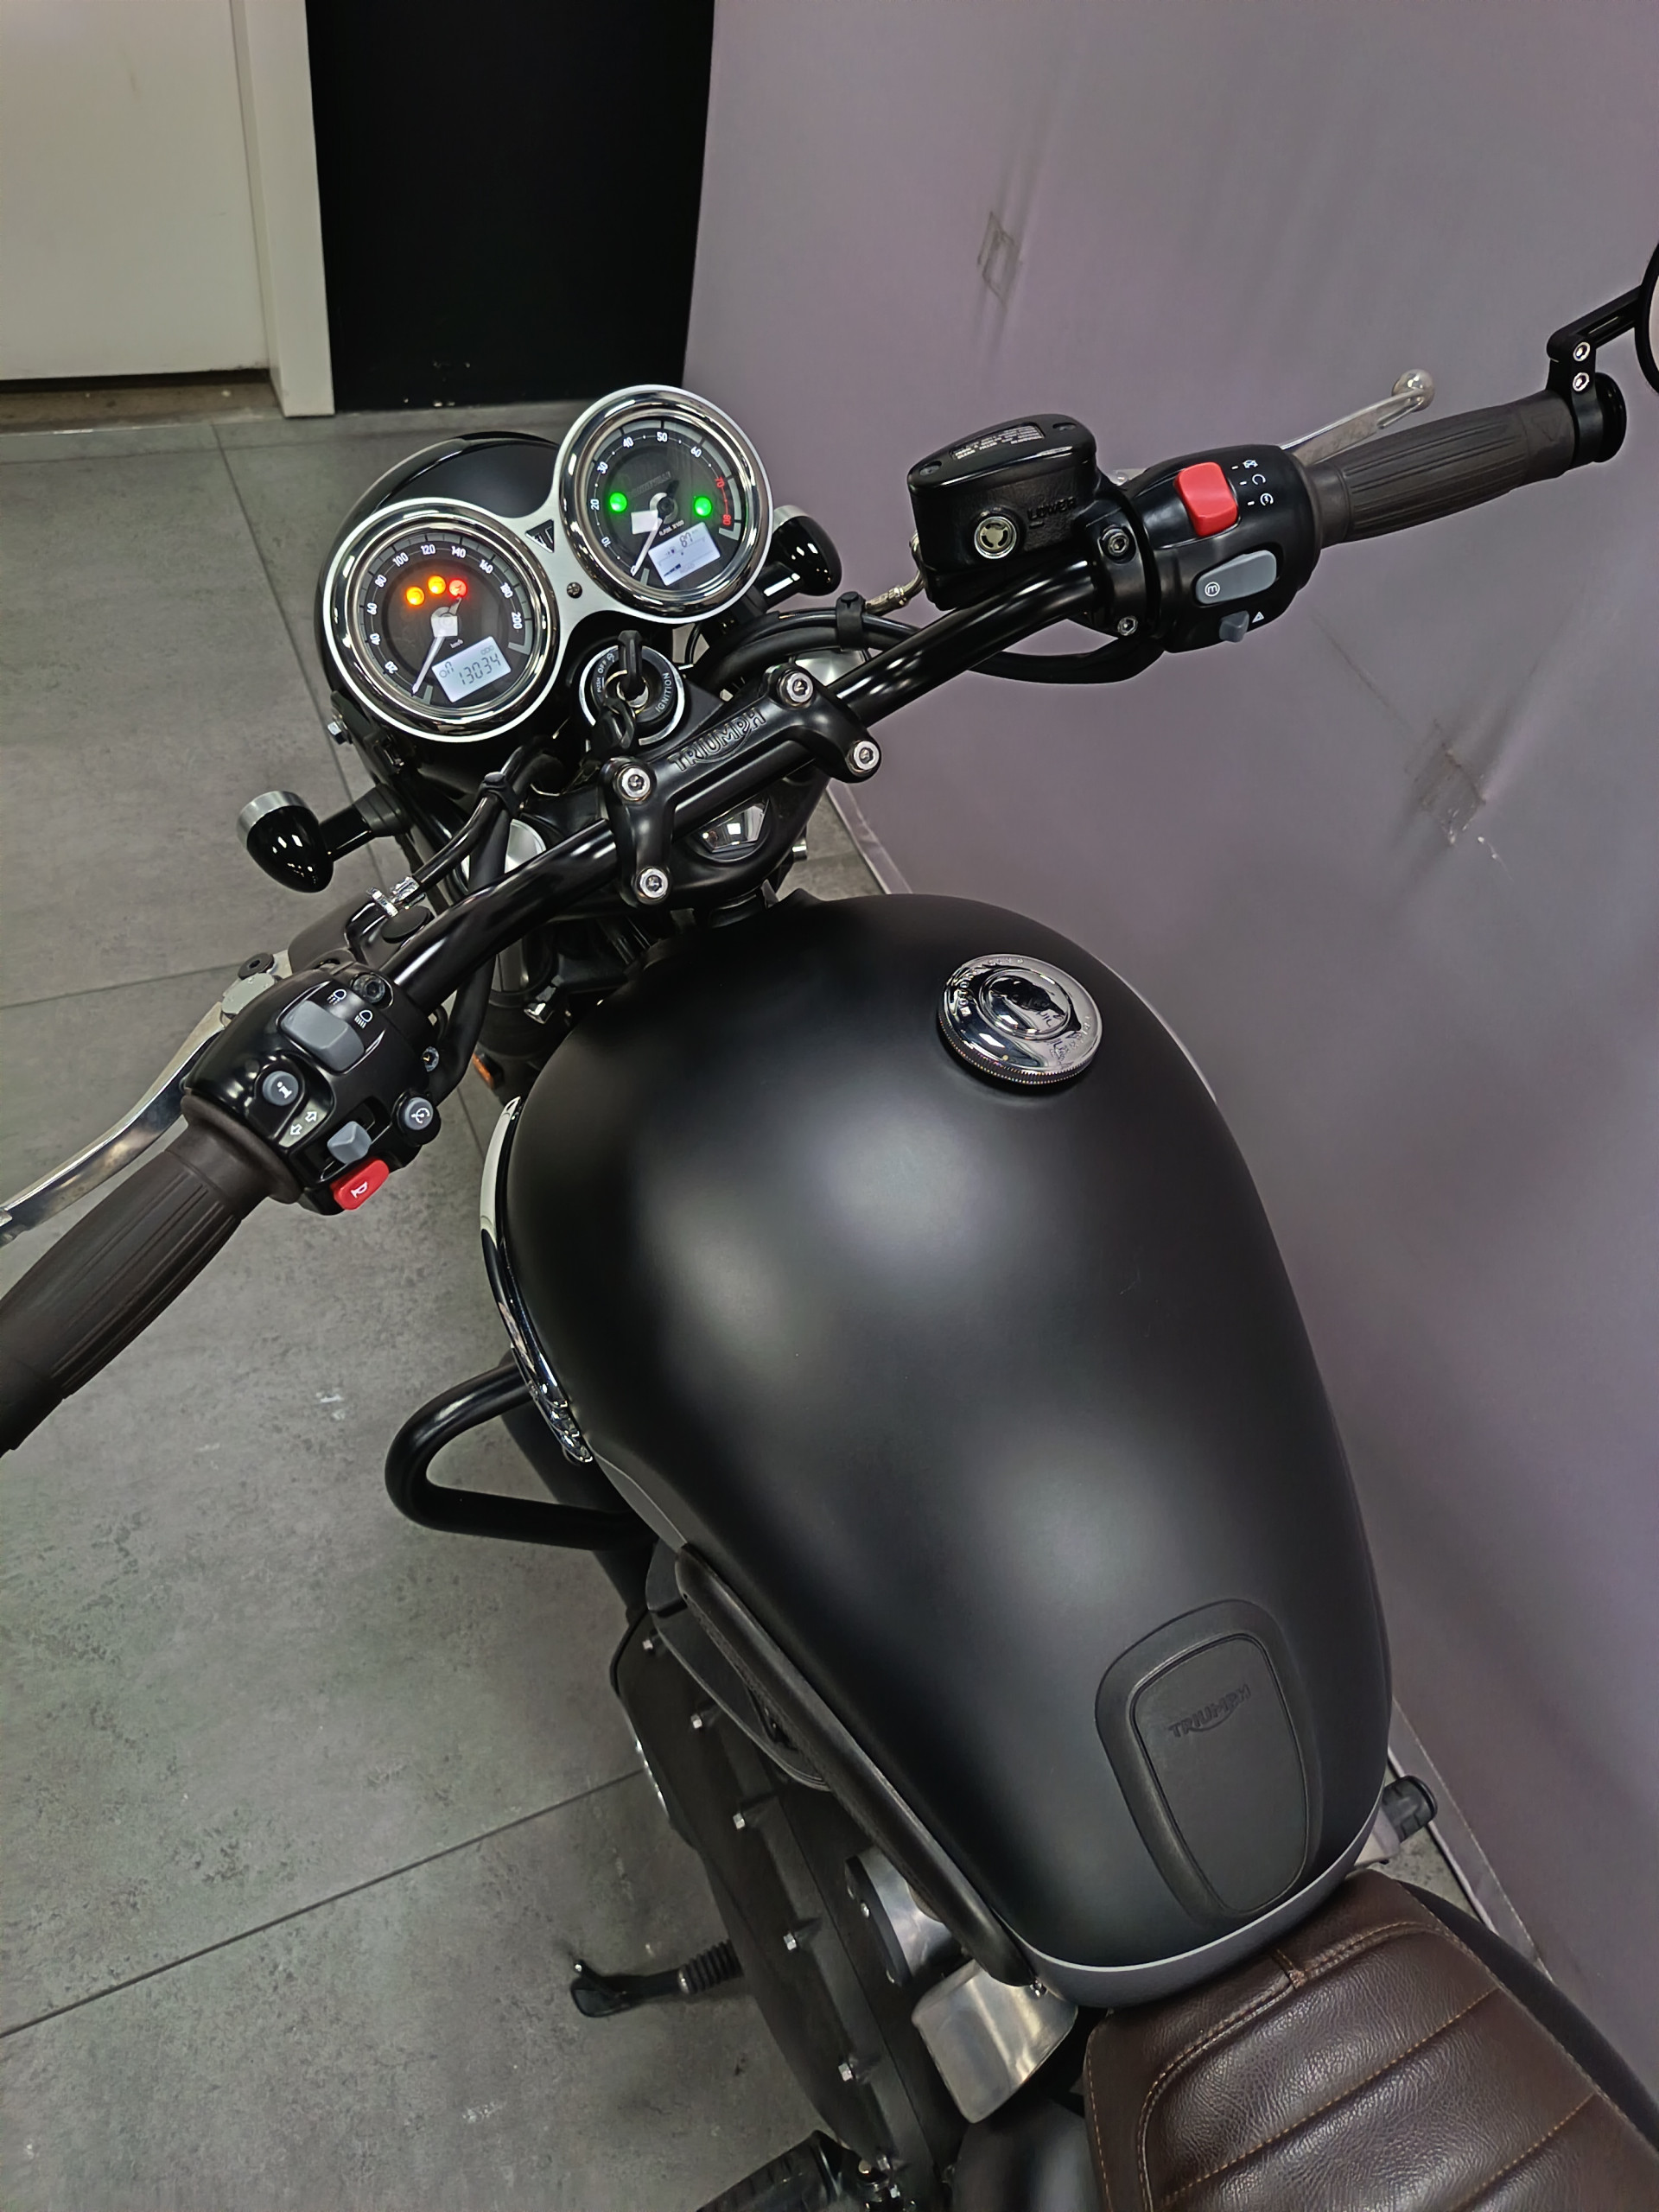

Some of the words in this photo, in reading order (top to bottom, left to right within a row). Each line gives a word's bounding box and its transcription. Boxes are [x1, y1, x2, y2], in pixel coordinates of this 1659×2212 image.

[622, 437, 634, 448] 40
[656, 432, 668, 442] 50
[690, 446, 702, 458] 60
[597, 461, 608, 474] 30
[715, 476, 725, 489] 70
[590, 499, 600, 511] 20
[722, 514, 732, 526] 80
[601, 537, 612, 548] 10
[420, 544, 436, 555] 120
[451, 546, 467, 558] 140
[392, 552, 409, 567] 100
[479, 559, 493, 574] 160
[374, 574, 387, 588] 80
[499, 582, 513, 599] 180
[366, 602, 378, 615] 60
[511, 612, 523, 630] 200
[369, 632, 381, 645] 40
[385, 661, 398, 674] 20
[458, 653, 501, 685] 13034
[655, 671, 673, 713] IGNITION
[667, 706, 766, 772] TRIUMPH
[1168, 1683, 1252, 1738] TRIUMPH
